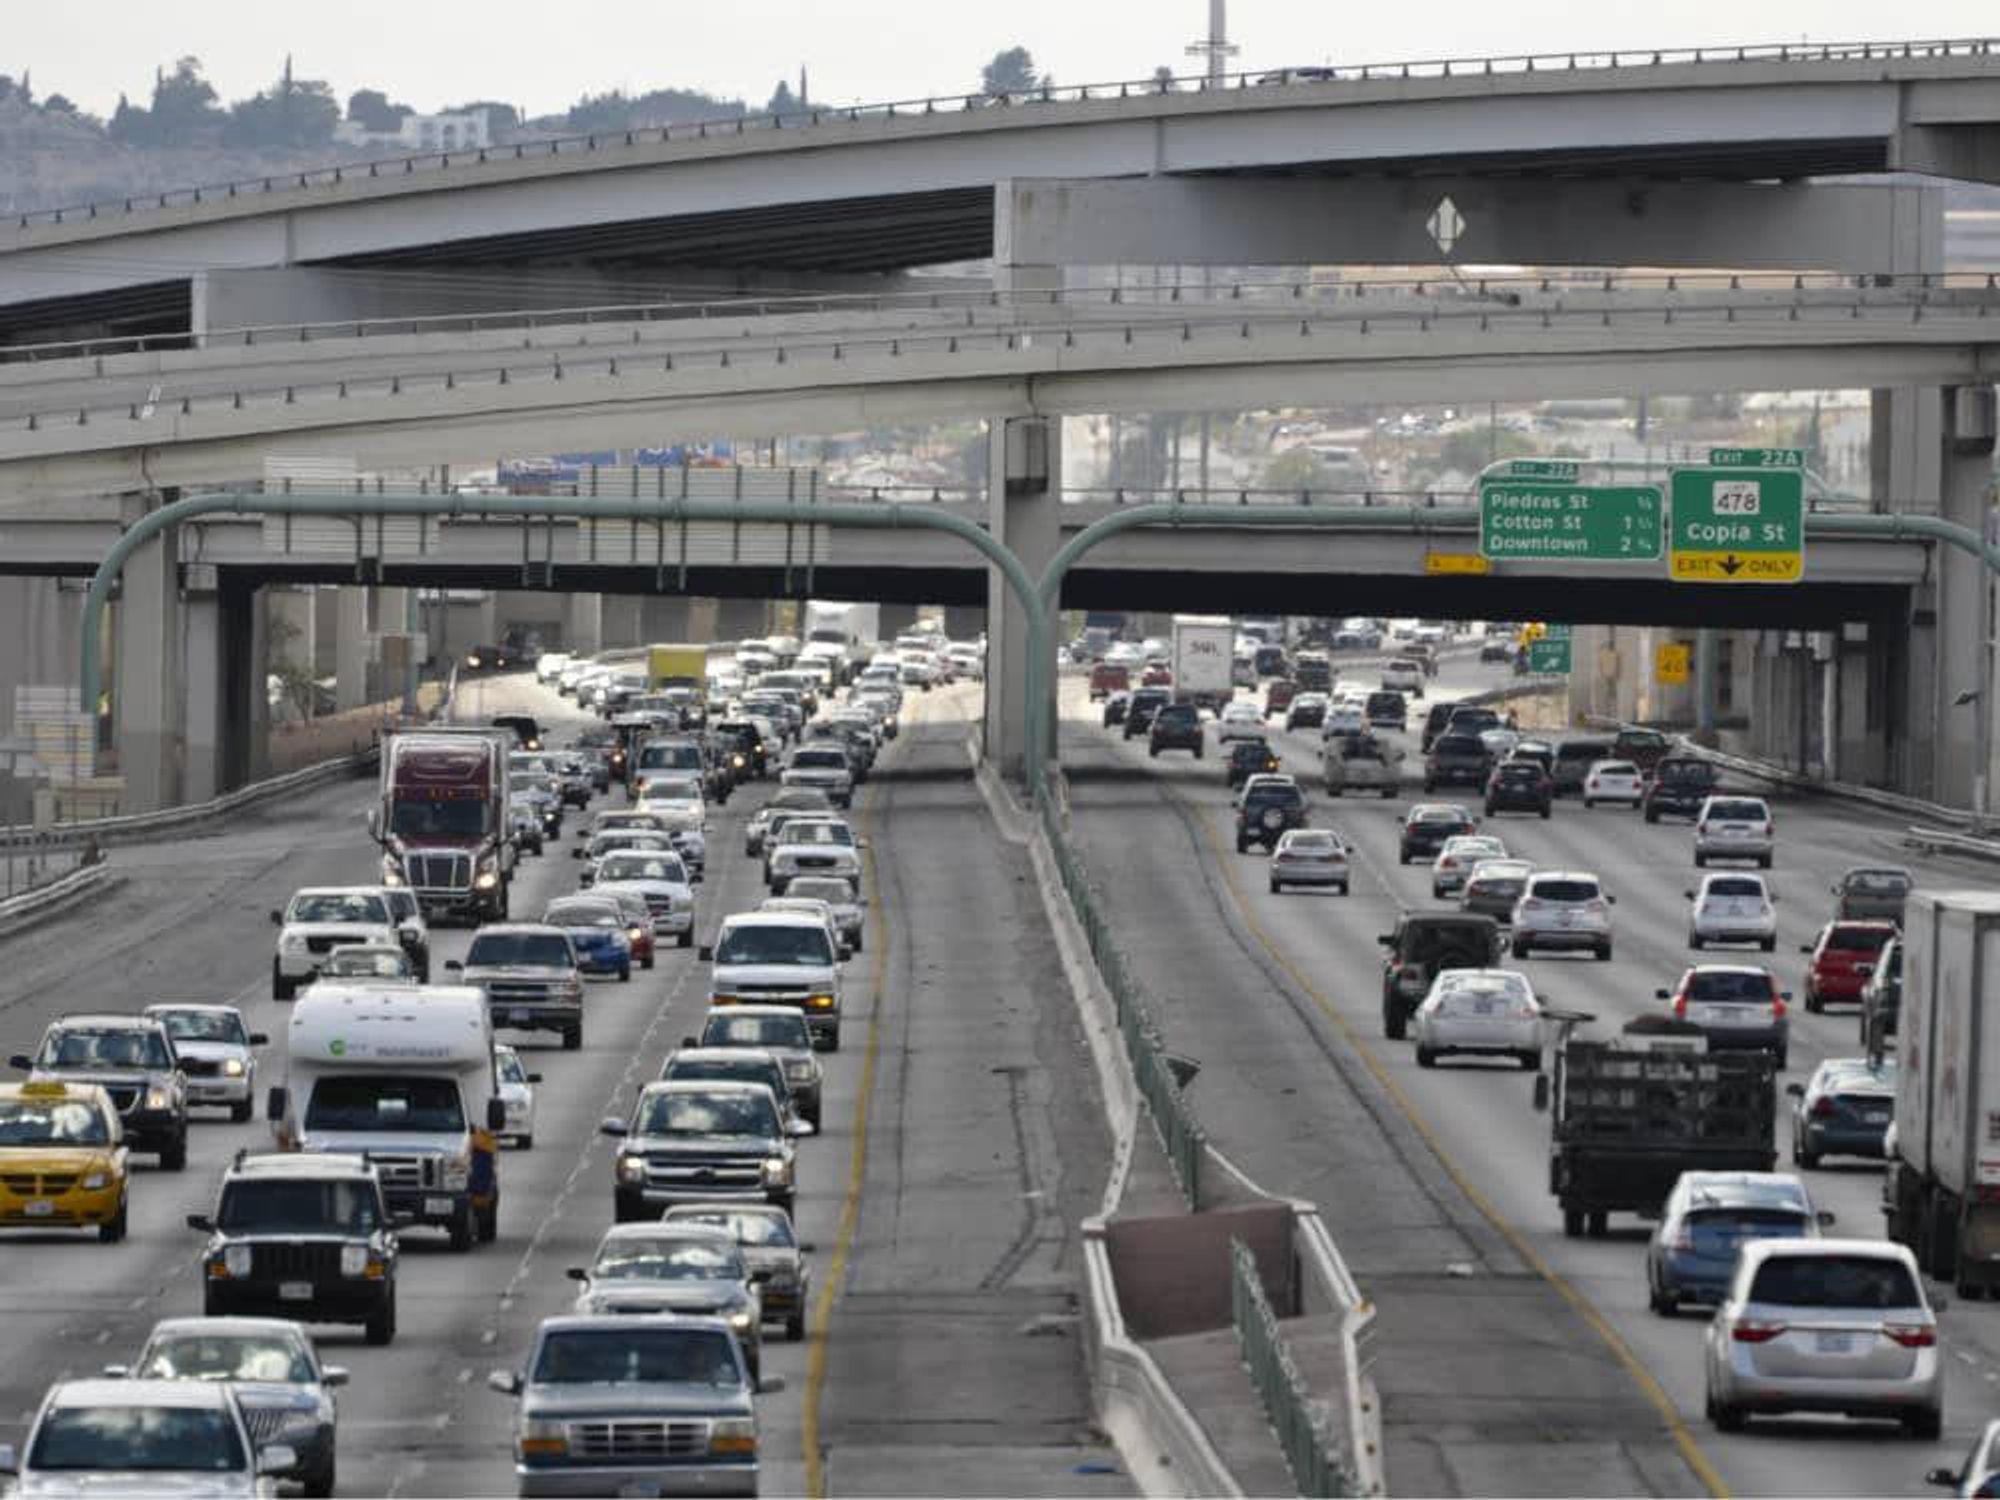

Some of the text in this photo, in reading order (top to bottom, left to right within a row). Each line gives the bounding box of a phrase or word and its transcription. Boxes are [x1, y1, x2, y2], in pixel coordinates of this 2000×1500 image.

[1761, 450, 1799, 465] 22A
[1492, 493, 1589, 509] Piedras St
[1717, 492, 1756, 511] 478
[1492, 514, 1554, 529] Cotton
[1563, 515, 1582, 529] St
[1687, 522, 1786, 545] Copia St
[1491, 535, 1588, 550] Downtown
[1677, 558, 1794, 573] EXIT ONLY
